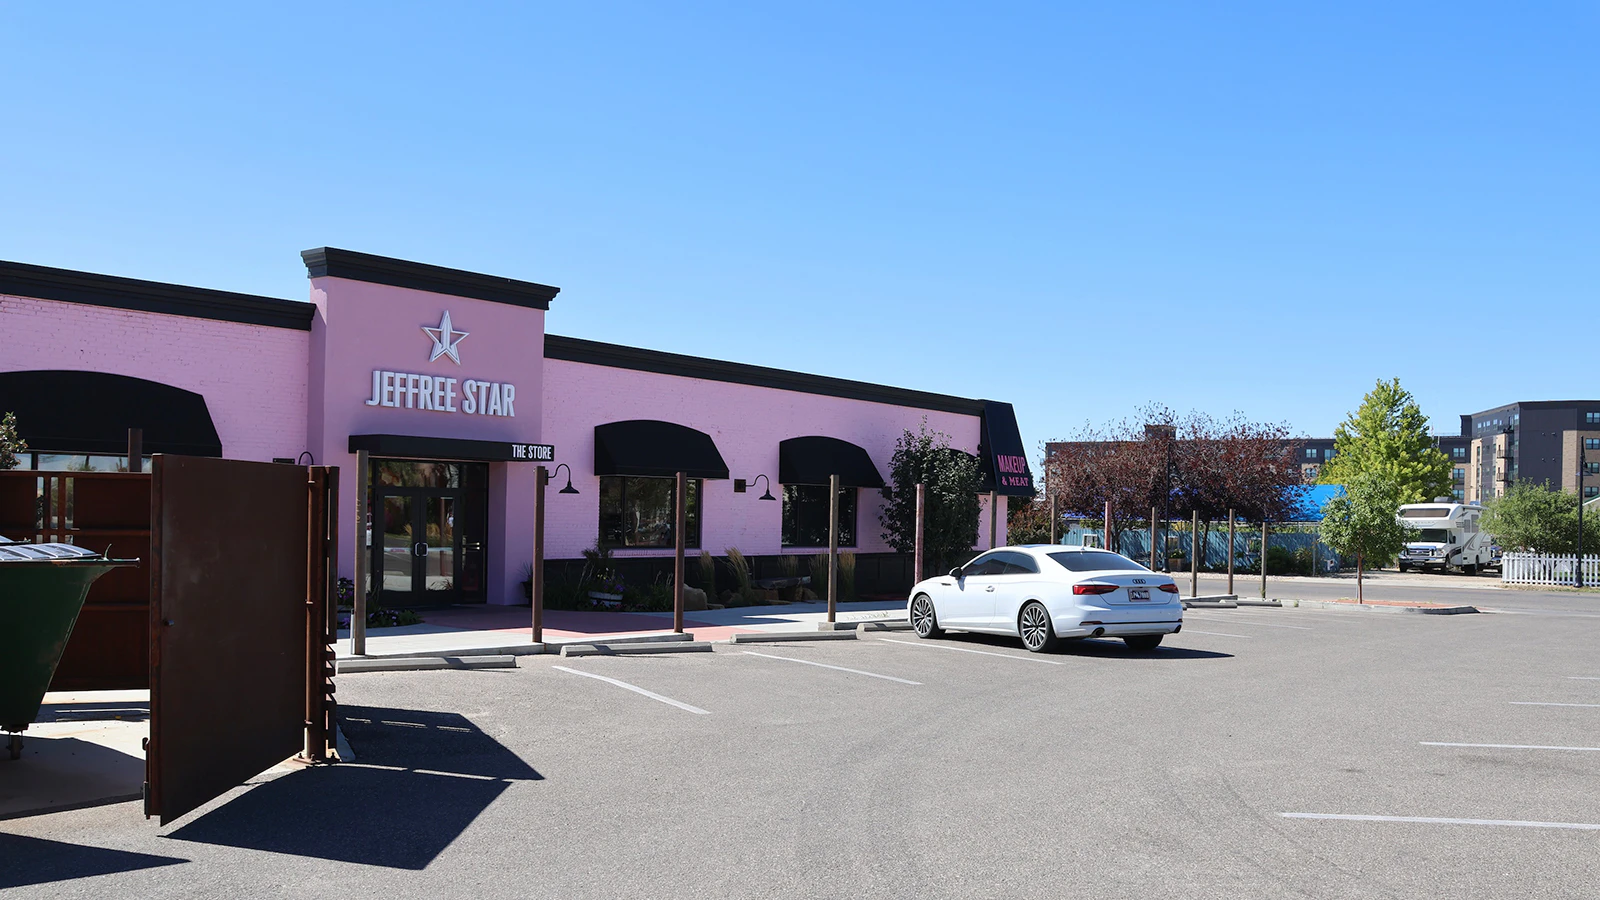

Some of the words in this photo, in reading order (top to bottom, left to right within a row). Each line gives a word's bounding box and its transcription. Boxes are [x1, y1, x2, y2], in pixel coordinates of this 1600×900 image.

[365, 370, 457, 412] JEFFREE
[462, 379, 516, 417] STAR
[512, 445, 526, 458] THE
[528, 446, 552, 460] STORE
[997, 455, 1026, 474] MAKEUP
[1001, 476, 1008, 486] &
[1008, 477, 1029, 486] MEAT
